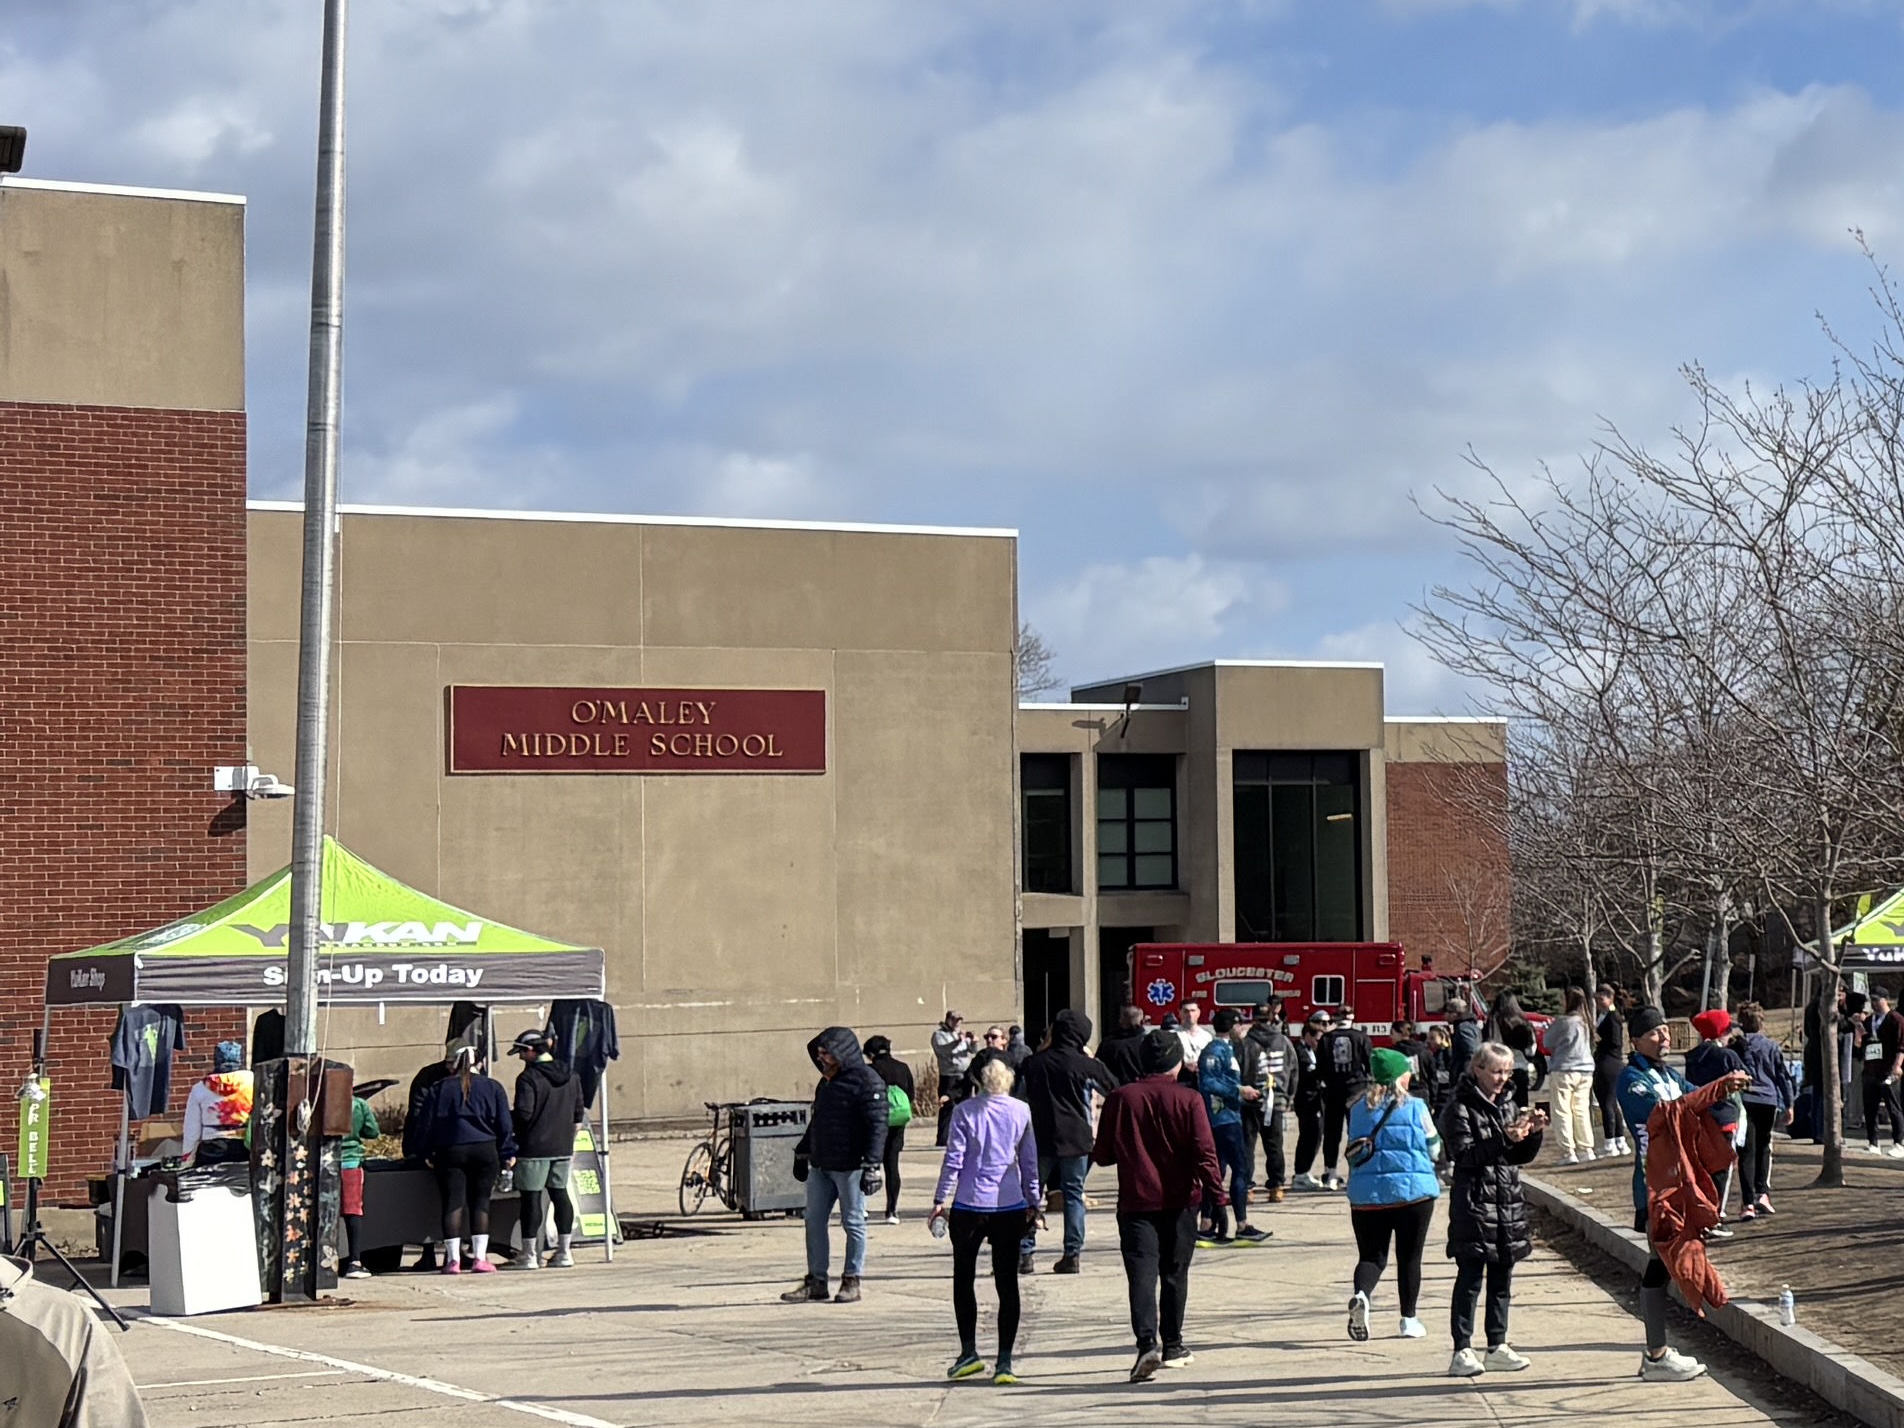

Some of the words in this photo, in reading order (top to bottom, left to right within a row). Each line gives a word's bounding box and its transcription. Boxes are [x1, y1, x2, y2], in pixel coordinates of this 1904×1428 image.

[572, 700, 717, 725] O'MALEY
[502, 732, 630, 756] MIDDLE
[650, 733, 783, 757] SCHOOL
[392, 964, 484, 988] Today
